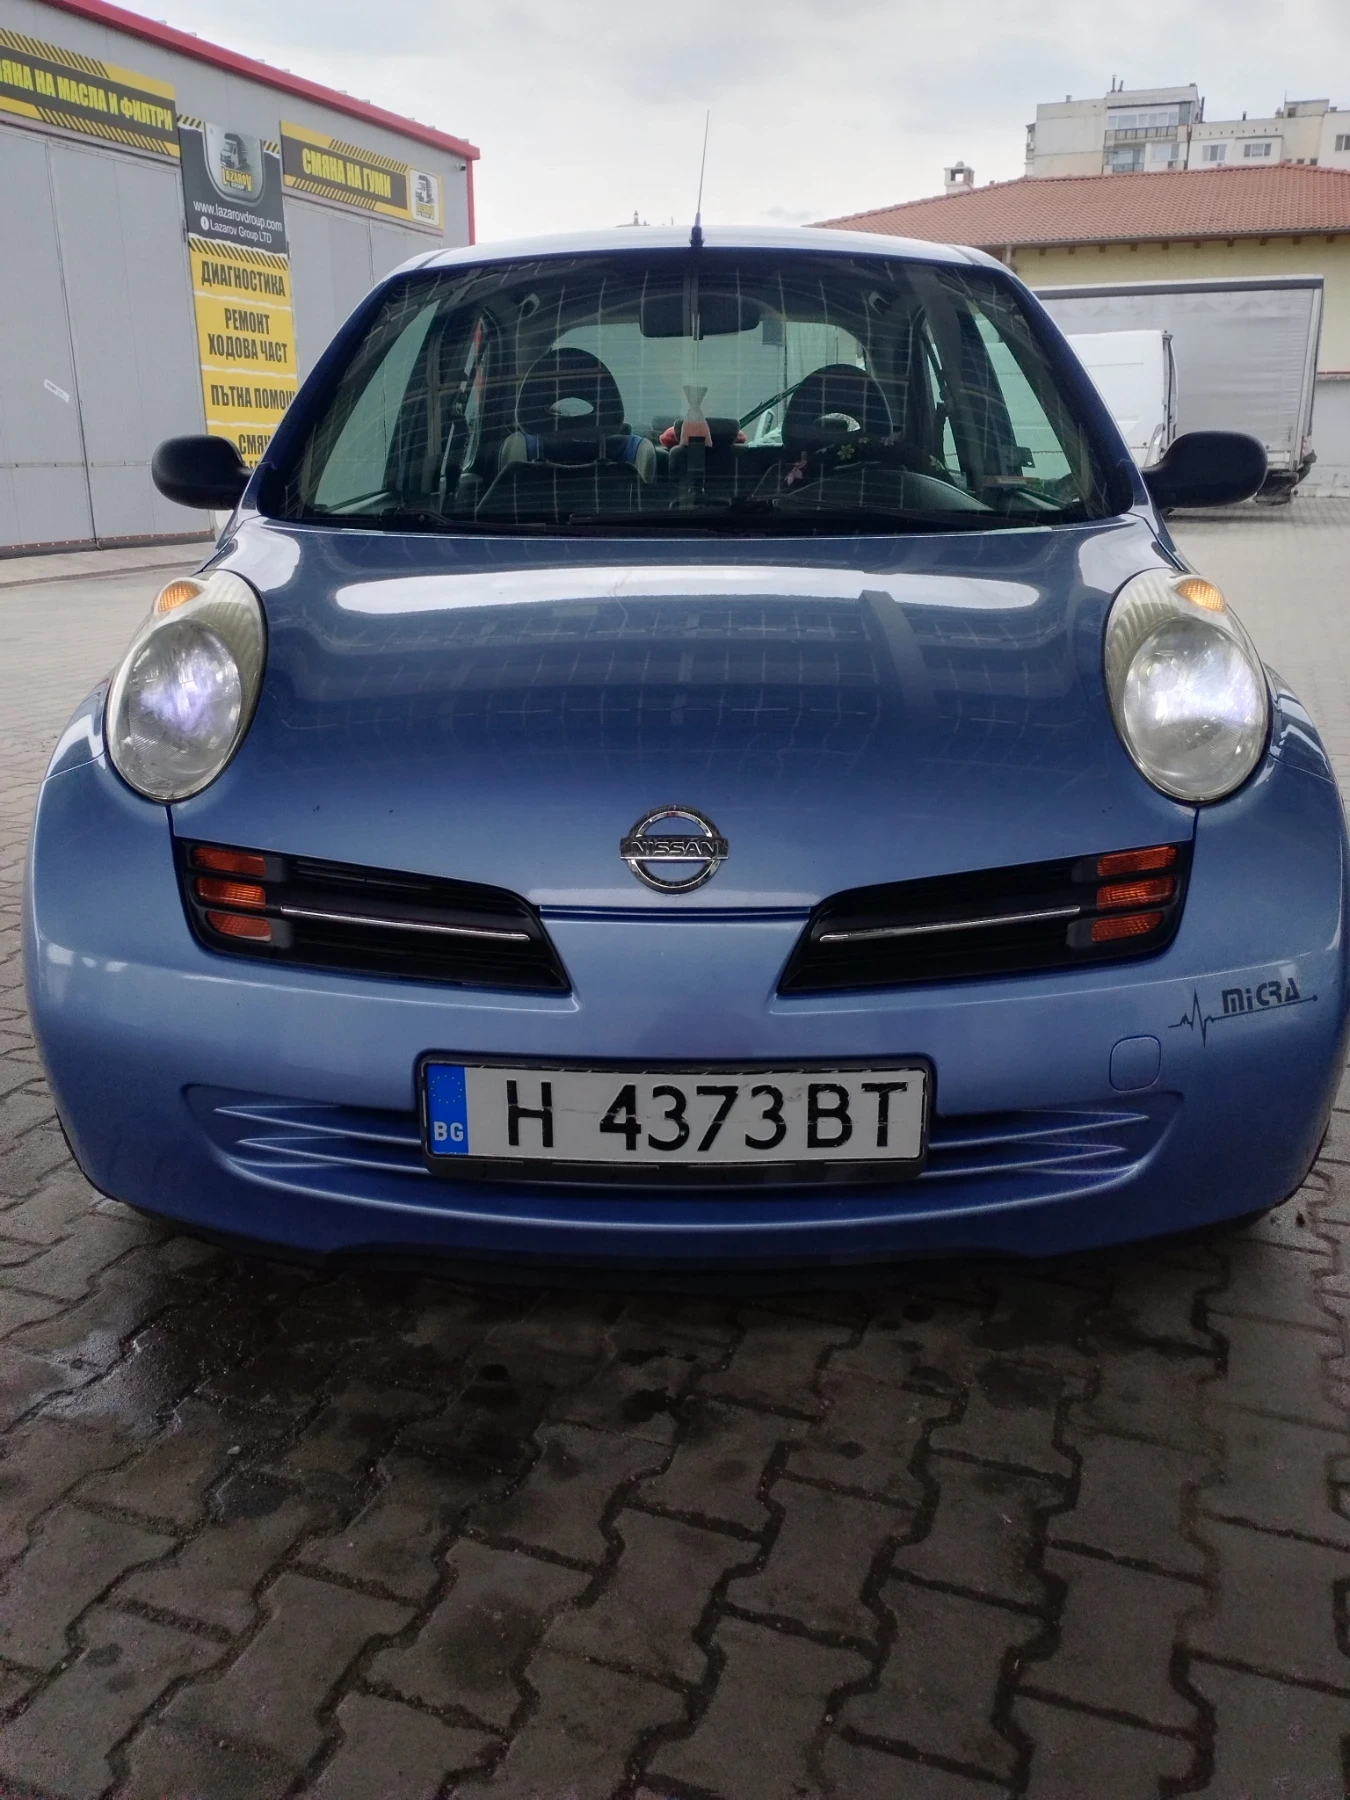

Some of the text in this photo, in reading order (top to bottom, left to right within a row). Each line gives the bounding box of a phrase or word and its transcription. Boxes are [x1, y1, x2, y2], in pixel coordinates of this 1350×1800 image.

[0, 59, 173, 132] ЯНА НА МАСЛА И ФИЛТРИ
[221, 166, 252, 192] LAZAROV
[302, 148, 392, 198] СМЯНА НА ГУМИ
[210, 219, 272, 244] Lazarov Group LTD
[201, 260, 286, 297] ДИАГНОСТИКА
[224, 308, 270, 335] РЕМОНТ
[208, 333, 288, 363] ХОДОВА ЧАСТ
[210, 384, 253, 408] ПЪТНА
[631, 841, 719, 856] NISSAN
[433, 1121, 464, 1142] BG
